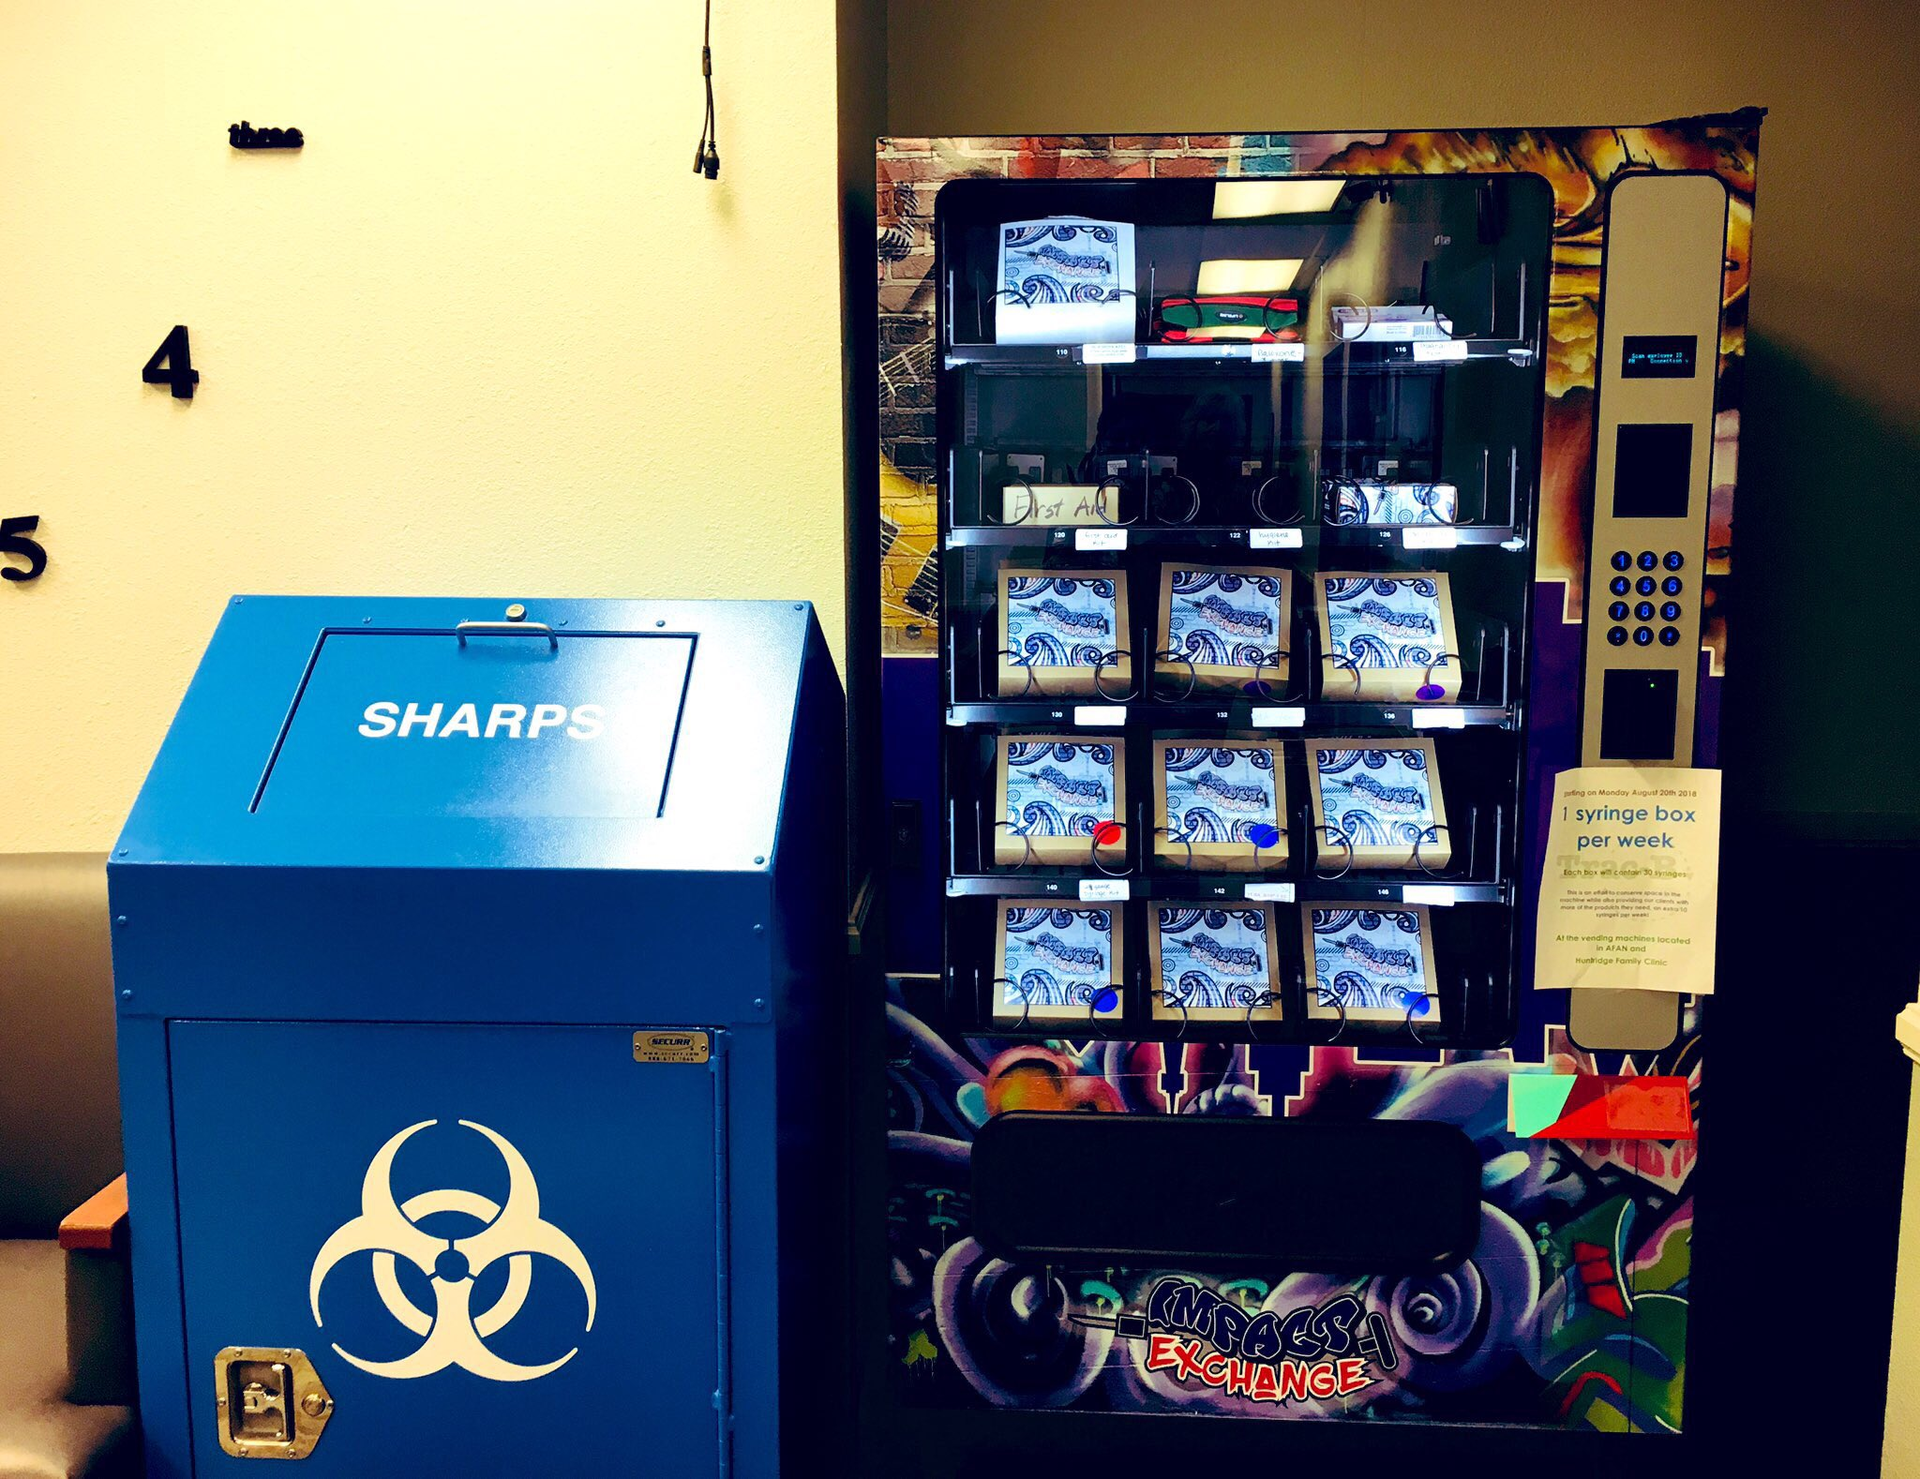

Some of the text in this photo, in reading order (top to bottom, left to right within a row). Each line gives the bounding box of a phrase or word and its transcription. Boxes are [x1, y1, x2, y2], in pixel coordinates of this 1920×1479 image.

[142, 325, 199, 399] 4
[0, 515, 47, 581] 5
[1618, 554, 1678, 567] 1 2 3
[1616, 580, 1677, 592] 4 5 6
[1616, 605, 1675, 617] 7 8 9
[1640, 630, 1648, 641] 0
[358, 701, 605, 740] SHARPS
[1576, 805, 1649, 825] syringe
[1655, 805, 1696, 822] box
[1577, 832, 1675, 851] per week
[1654, 870, 1686, 878] syringes
[1581, 935, 1613, 943] vending
[1615, 935, 1655, 943] machines
[1657, 936, 1691, 945] located
[1615, 957, 1642, 966] Family
[1644, 958, 1668, 967] Clinic
[652, 1038, 690, 1046] SECURR
[1148, 1278, 1363, 1360] IMPACT
[1147, 1334, 1374, 1401] EXCHANGE
